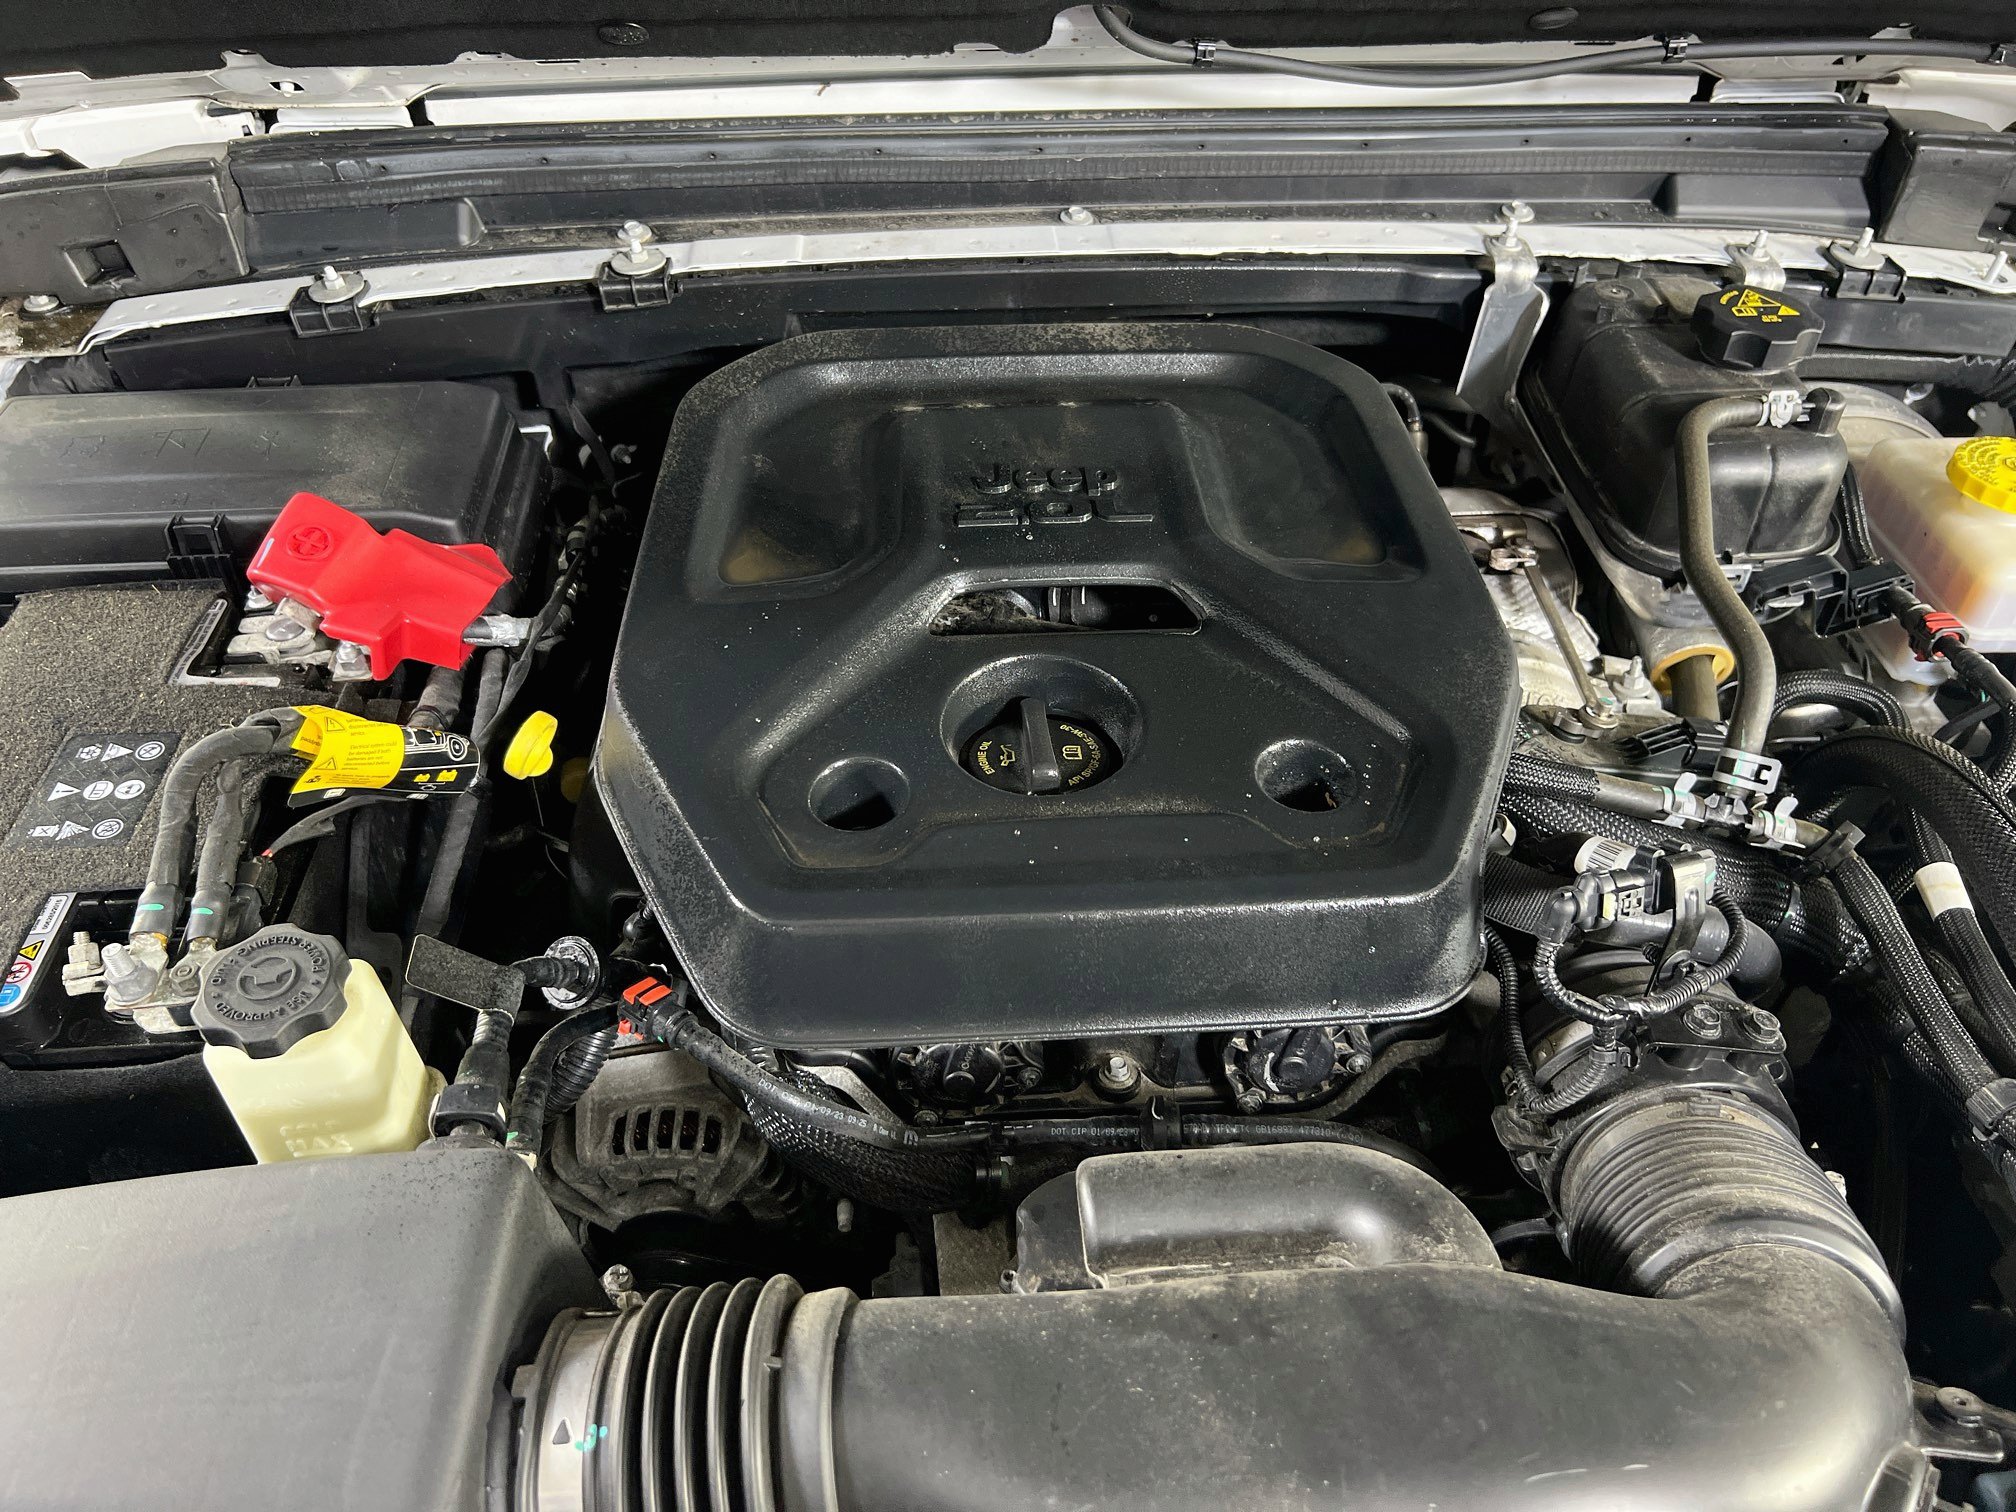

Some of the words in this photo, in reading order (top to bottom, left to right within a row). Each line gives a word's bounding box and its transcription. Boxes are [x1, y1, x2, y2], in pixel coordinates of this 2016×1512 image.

[969, 462, 1120, 498] Jeep
[953, 499, 1155, 529] 2.0L
[979, 740, 993, 751] OIL
[977, 751, 995, 776] ENGINE
[1068, 774, 1085, 787] API
[237, 935, 300, 958] STEERING
[299, 940, 328, 974] POWER
[215, 1001, 288, 1022] APPROVED
[758, 1078, 777, 1092] DOT
[1051, 1127, 1067, 1136] DOT
[1071, 1127, 1087, 1136] CIP
